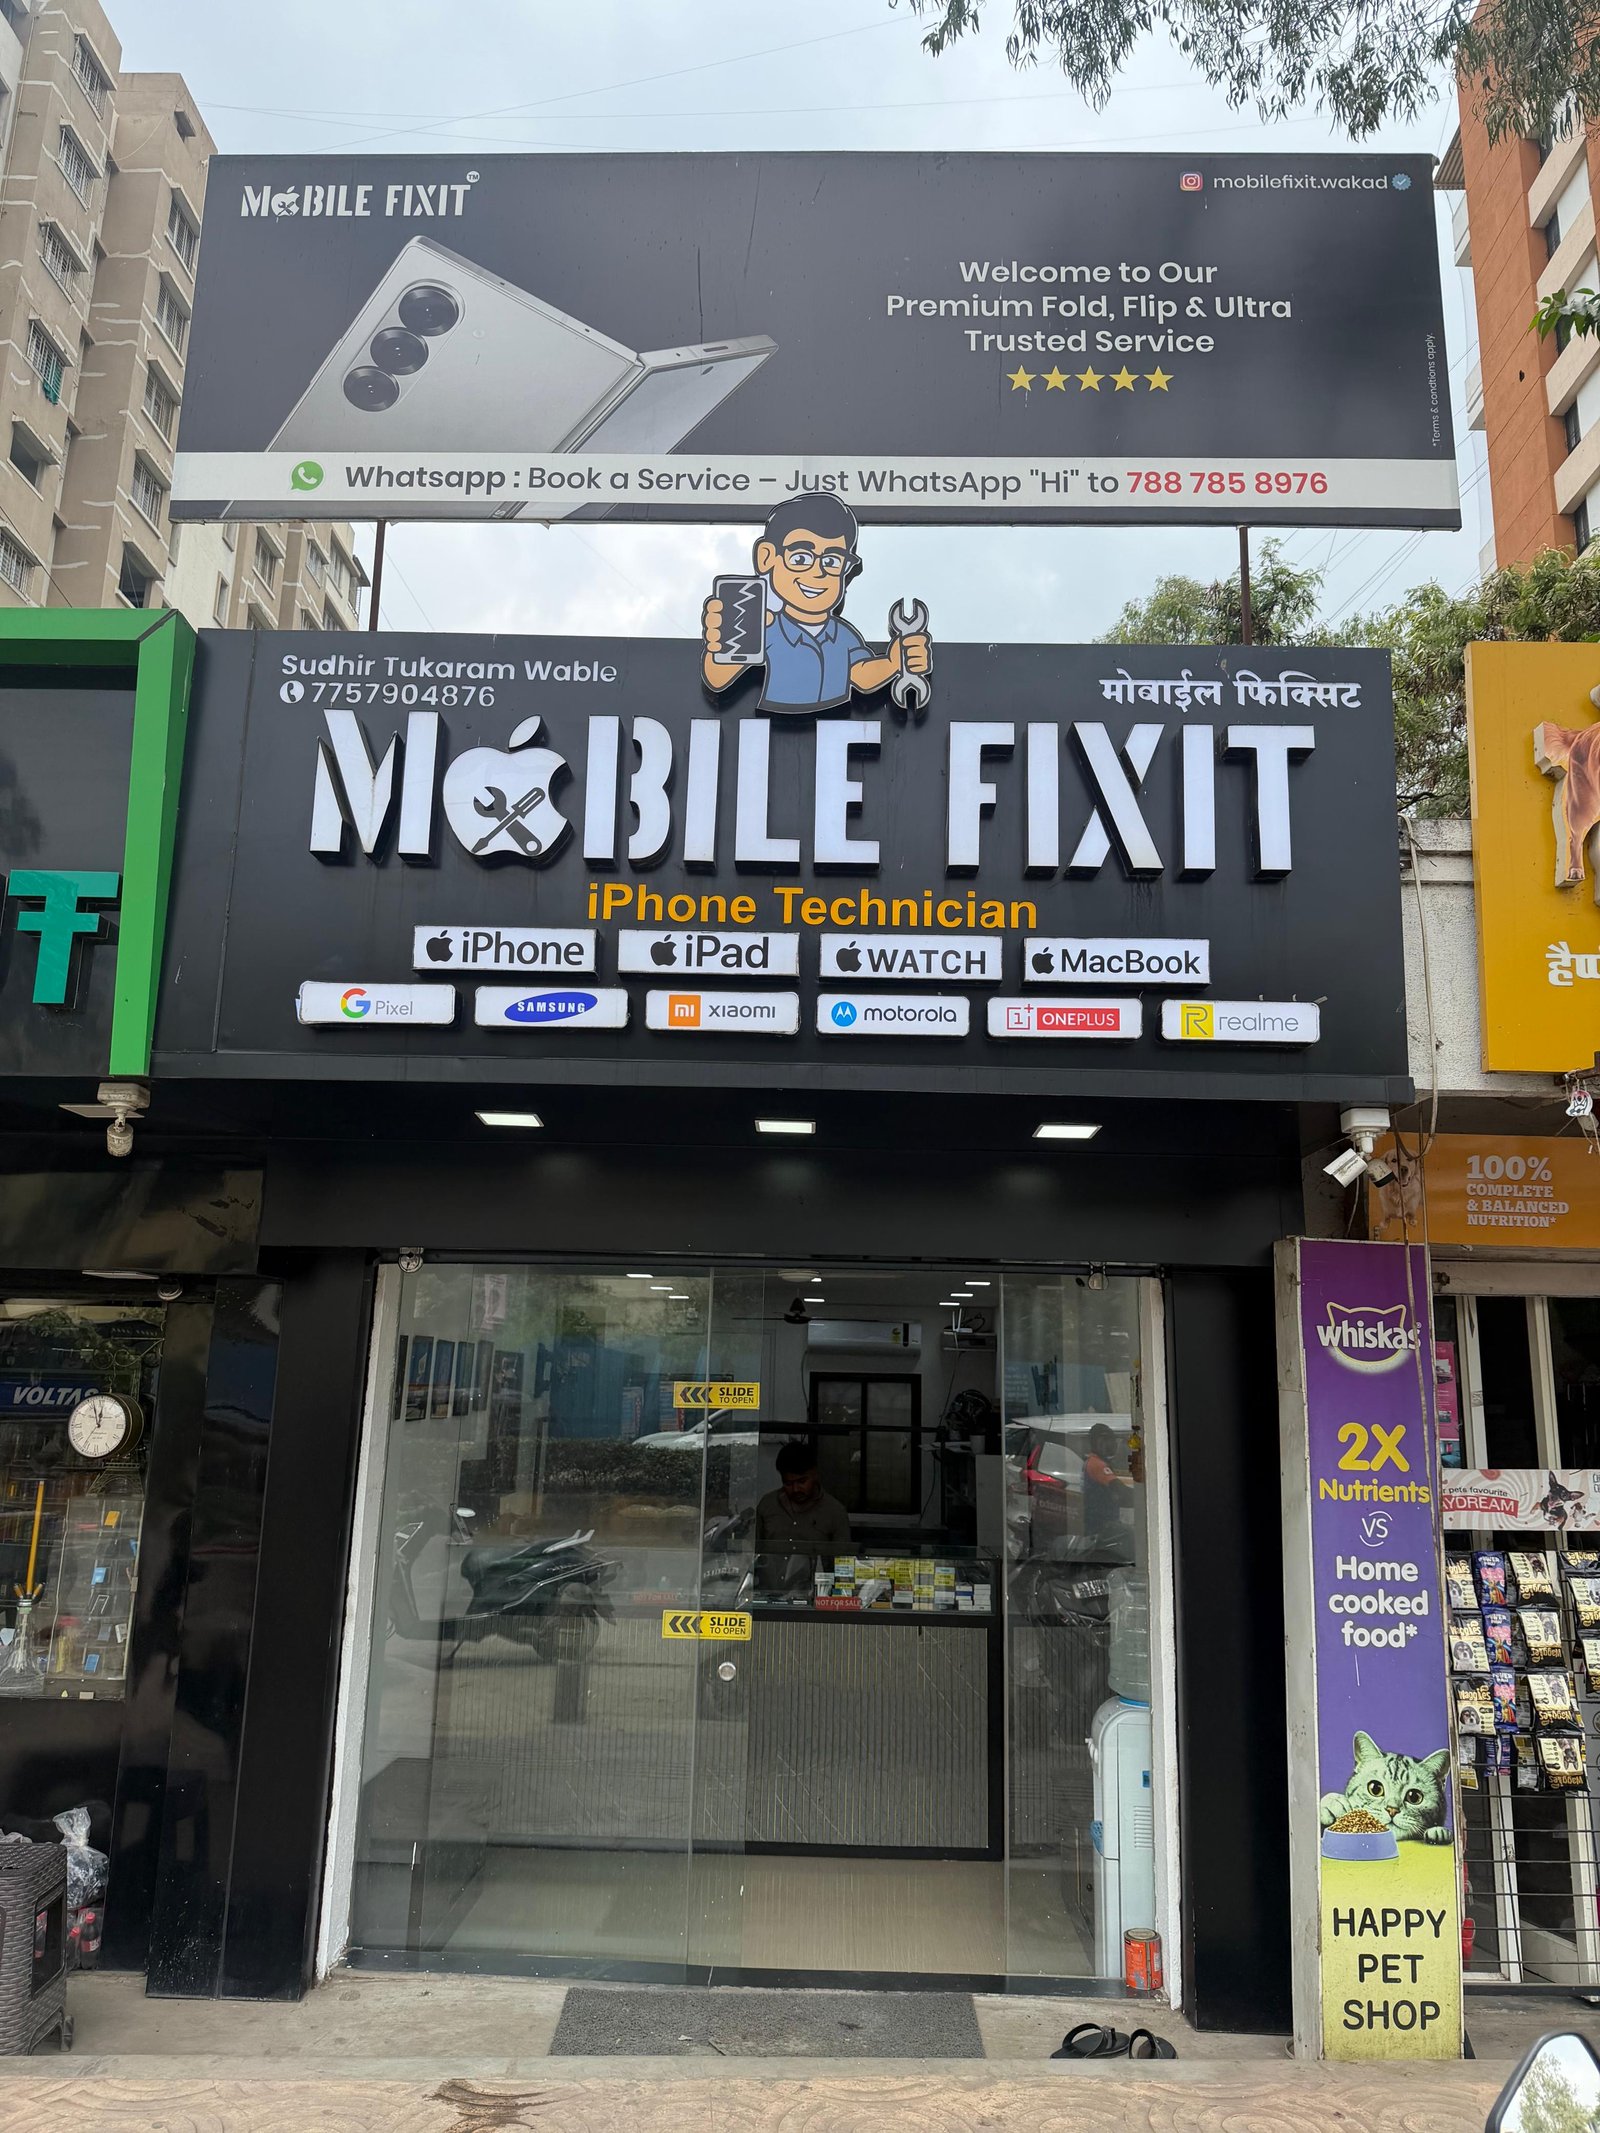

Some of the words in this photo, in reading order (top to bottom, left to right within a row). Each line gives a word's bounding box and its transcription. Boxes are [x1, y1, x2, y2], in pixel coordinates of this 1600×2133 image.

[1213, 172, 1388, 191] mobilefixit.wakad
[385, 184, 471, 217] FIXIT
[958, 261, 1111, 285] Welcome
[1118, 264, 1150, 284] to
[1159, 261, 1217, 285] Our
[886, 295, 1033, 319] Premium
[1041, 295, 1116, 323] Fold,
[1122, 295, 1178, 324] Flip
[1186, 298, 1207, 319] &
[1215, 297, 1292, 319] Ultra
[965, 329, 1087, 353] Trusted
[1095, 330, 1214, 353] Service
[345, 465, 505, 495] Whatsapp
[528, 467, 601, 490] Book
[609, 472, 629, 490] a
[637, 467, 751, 491] Service
[785, 470, 849, 494] Just
[857, 470, 1021, 500] WhatsApp
[1029, 470, 1079, 493] "Hi"
[1087, 474, 1119, 493] to
[1126, 471, 1181, 495] 788
[1189, 472, 1246, 495] 785
[1254, 472, 1329, 496] 8976
[282, 654, 375, 677] Sudhir
[384, 657, 515, 680] Tukaram
[523, 660, 617, 683] Wable
[312, 682, 495, 707] 7757904876
[1099, 668, 1223, 713] मोबाईल
[946, 720, 1316, 876] FIXIT
[588, 883, 757, 924] iPhone
[773, 887, 1038, 931] Technician
[462, 931, 584, 966] iPhone
[685, 935, 770, 969] iPad
[867, 948, 987, 975] WATCH
[1061, 949, 1200, 975] MacBook
[375, 1001, 413, 1016] Pixel
[517, 1001, 586, 1015] SAMSUNG
[863, 1005, 957, 1024] motorola
[1042, 1013, 1115, 1027] ONEPLUS
[1219, 1013, 1299, 1032] realme
[1466, 1156, 1553, 1182] 100%
[1466, 1184, 1554, 1198] COMPLETE
[1467, 1201, 1479, 1212] &
[1483, 1200, 1570, 1214] BALANCED
[719, 1387, 754, 1396] SLIDE
[1338, 1422, 1410, 1472] 2X
[1319, 1478, 1431, 1503] Nutrients
[1470, 1487, 1508, 1497] favourite
[1361, 1518, 1388, 1538] VS
[1336, 1556, 1418, 1582] Home
[816, 1599, 830, 1607] NOT
[831, 1599, 844, 1607] FOR
[1328, 1589, 1429, 1616] cooked
[710, 1617, 746, 1627] SLIDE
[723, 1627, 746, 1635] OPEN
[1333, 1907, 1447, 1939] HAPPY
[1358, 1954, 1425, 1984] PET
[1342, 1999, 1441, 2031] SHOP
